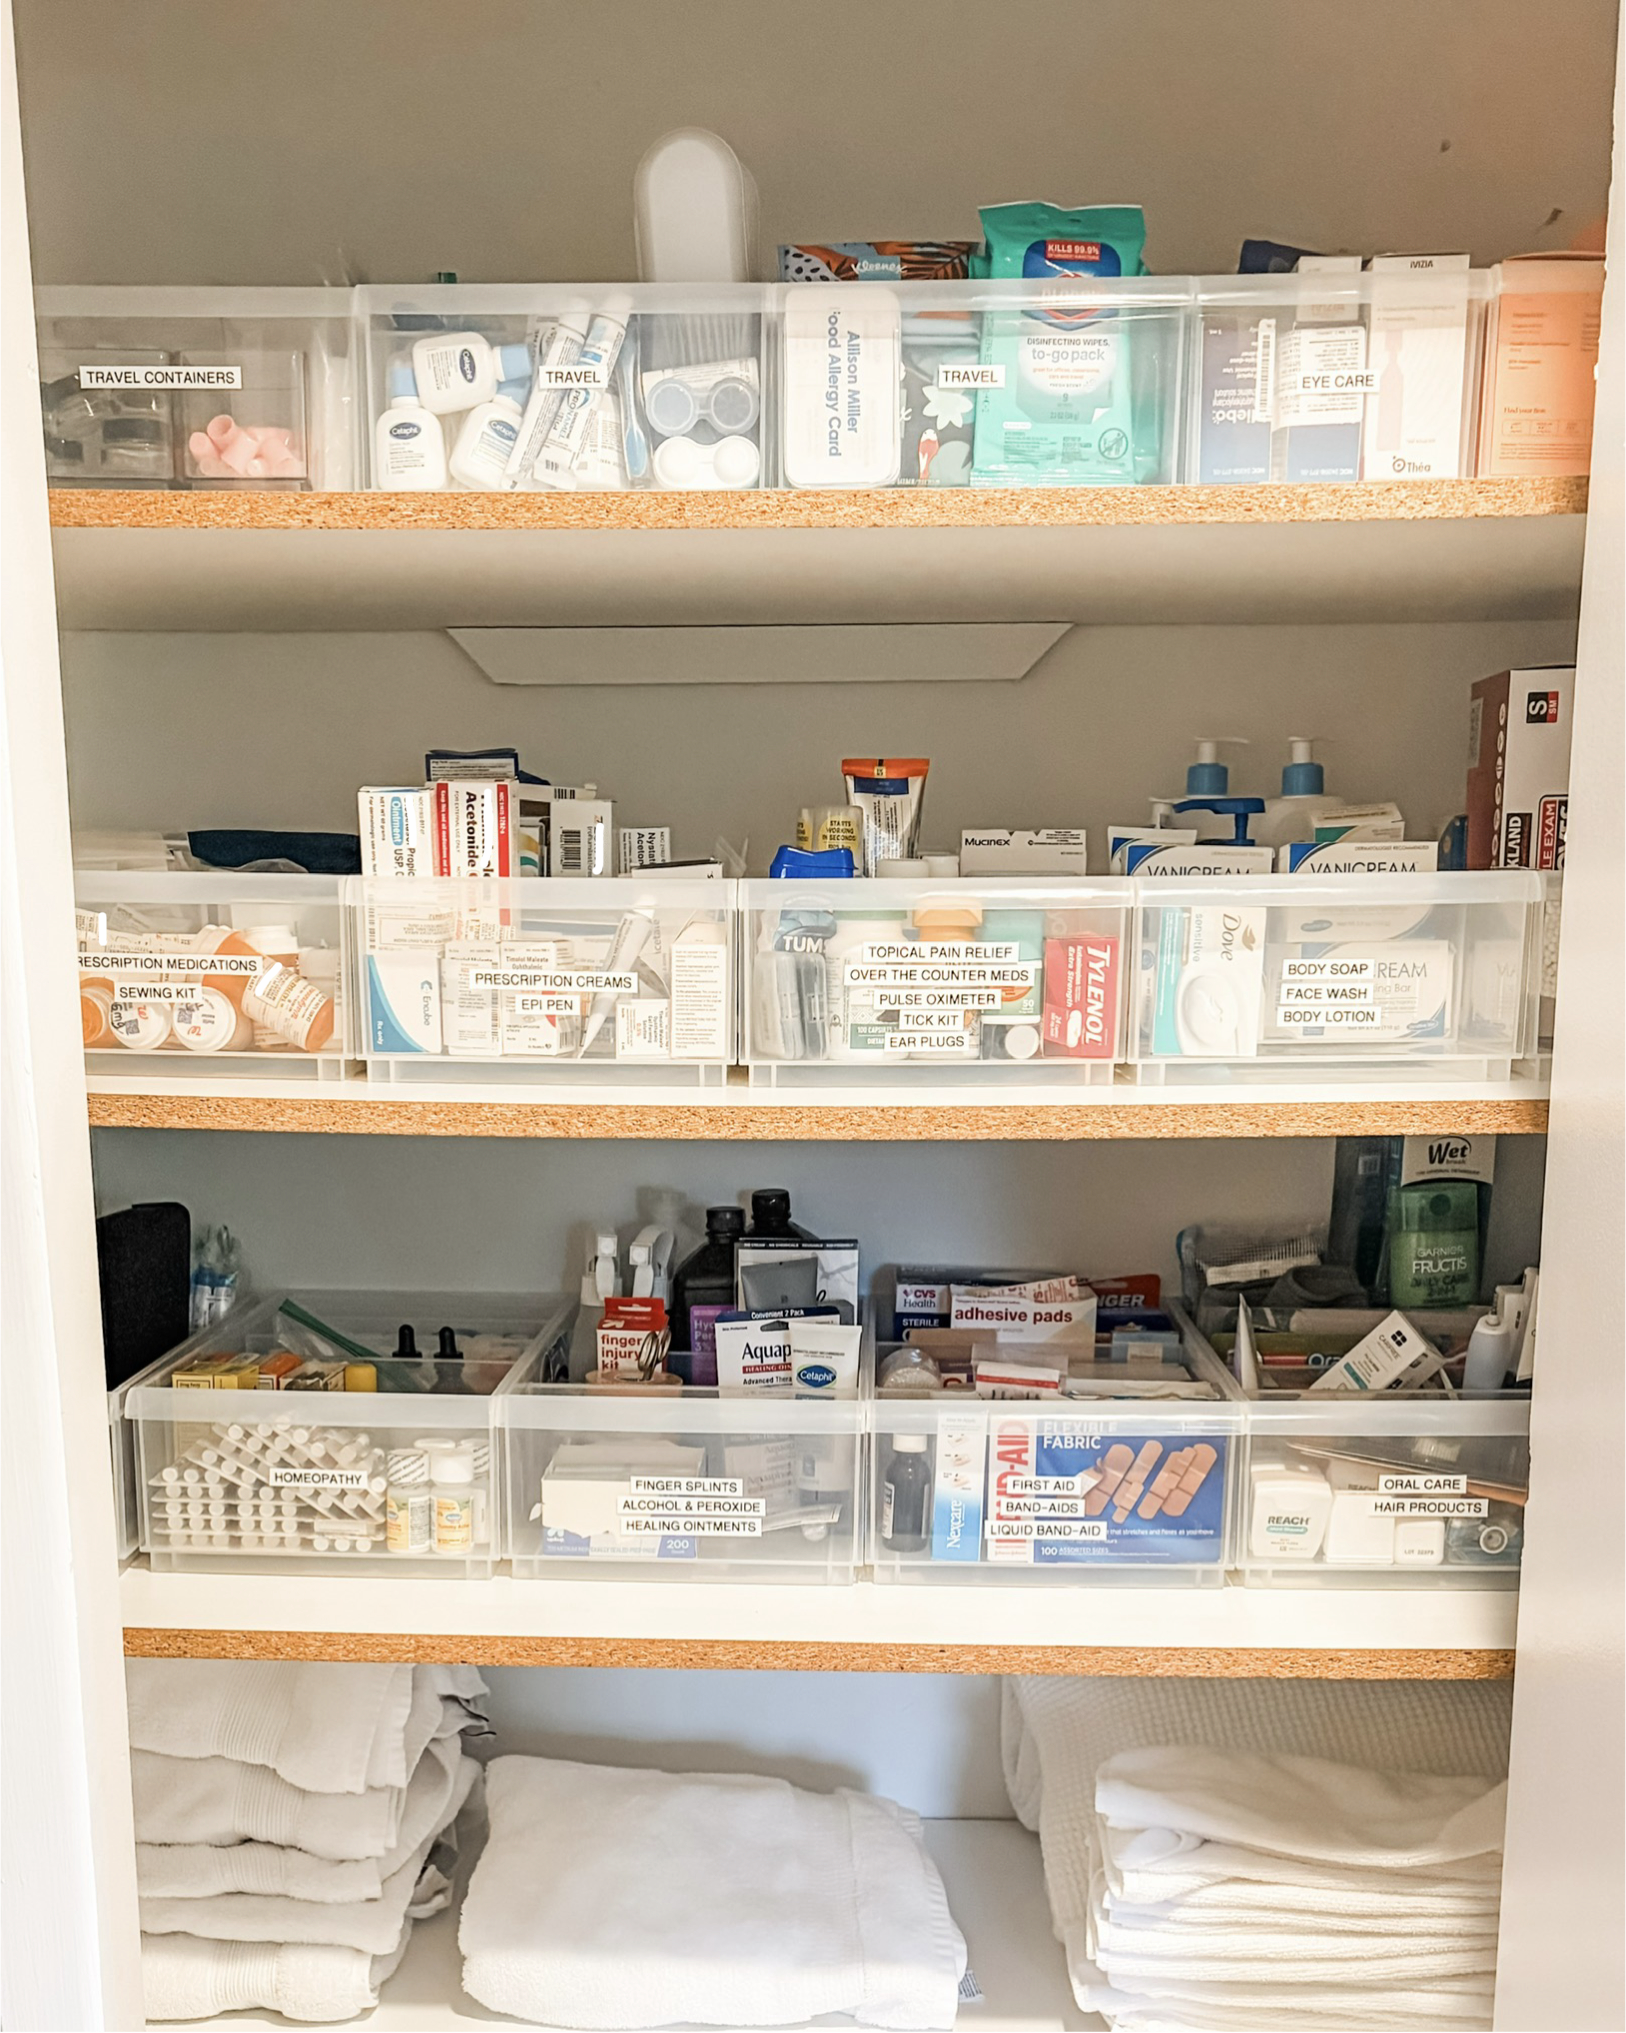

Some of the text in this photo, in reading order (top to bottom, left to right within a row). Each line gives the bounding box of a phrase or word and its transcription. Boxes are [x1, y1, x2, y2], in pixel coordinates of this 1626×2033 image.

[1047, 244, 1073, 254] KILLS
[851, 260, 908, 274] Kleenex
[1027, 338, 1081, 346] DISINFECTING
[1032, 348, 1105, 363] to-go pack
[86, 371, 236, 384] TRAVEL CONTAINERS
[546, 372, 600, 384] TRAVEL
[847, 331, 861, 433] Allison Miller
[942, 370, 998, 383] TRAVEL
[1302, 375, 1374, 388] EYE CARE
[826, 312, 841, 457] ood Allergy Card
[391, 425, 421, 437] Cetaphil
[392, 800, 402, 843] Ointment
[1544, 803, 1556, 846] EXAM
[466, 791, 478, 868] Acetonide
[1192, 914, 1203, 962] sensitive
[1220, 913, 1242, 961] Dove
[868, 946, 1012, 958] TOPICAL PAIN RELIEF
[1067, 946, 1075, 969] Extra
[167, 958, 257, 971] MEDICATIONS
[1288, 964, 1368, 975] BODY SOAP
[475, 972, 632, 989] PRESCRIPTION CREAMS
[850, 969, 1029, 982] OVER THE COUNTER MEDS
[120, 986, 196, 998] SEWING KIT
[1286, 988, 1368, 1000] FACE WASH
[1394, 984, 1410, 992] Bar
[880, 994, 996, 1006] PULSE OXIMETER
[1085, 944, 1110, 1045] TYLENOL
[522, 999, 573, 1010] EPI PEN
[1022, 1000, 1034, 1008] 50
[904, 1014, 959, 1026] TICK KIT
[1284, 1011, 1375, 1022] BODY LOTION
[377, 1020, 384, 1030] Rx
[890, 1036, 964, 1048] EAR PLUGS
[1428, 1142, 1468, 1165] Wet
[1417, 1246, 1464, 1258] GARNIER
[1412, 1256, 1467, 1274] FRUCTIS
[914, 1289, 936, 1298] CVS
[904, 1299, 936, 1308] Health
[751, 1310, 783, 1320] Convenient
[790, 1308, 804, 1316] Pack
[955, 1306, 1072, 1325] adhesive pads
[902, 1318, 939, 1327] STERILE
[601, 1334, 642, 1348] finger
[602, 1347, 640, 1363] injury
[742, 1342, 792, 1364] Aquap
[602, 1360, 619, 1370] kit
[745, 1364, 777, 1373] HEALING
[743, 1376, 774, 1385] Advanced
[800, 1370, 833, 1382] Cetaphil
[1044, 1421, 1118, 1433] FLEXIBLE
[1044, 1436, 1101, 1450] FABRIC
[274, 1472, 362, 1485] HOMEOPATHY
[1384, 1478, 1460, 1490] ORAL CARE
[635, 1481, 738, 1493] FINGER SPLINTS
[1012, 1480, 1075, 1492] FIRST AID
[622, 1501, 760, 1513] ALCOHOL & PEROXIDE
[1006, 1502, 1078, 1514] BAND-AIDS
[1374, 1502, 1482, 1514] HAIR PRODUCTS
[626, 1521, 756, 1532] HEALING OINTMENTS
[947, 1499, 966, 1550] Nexcare
[1268, 1516, 1309, 1526] REACH
[990, 1525, 1100, 1536] LIQUID BAND-AID
[666, 1540, 689, 1549] 200
[1041, 1546, 1058, 1556] 100
